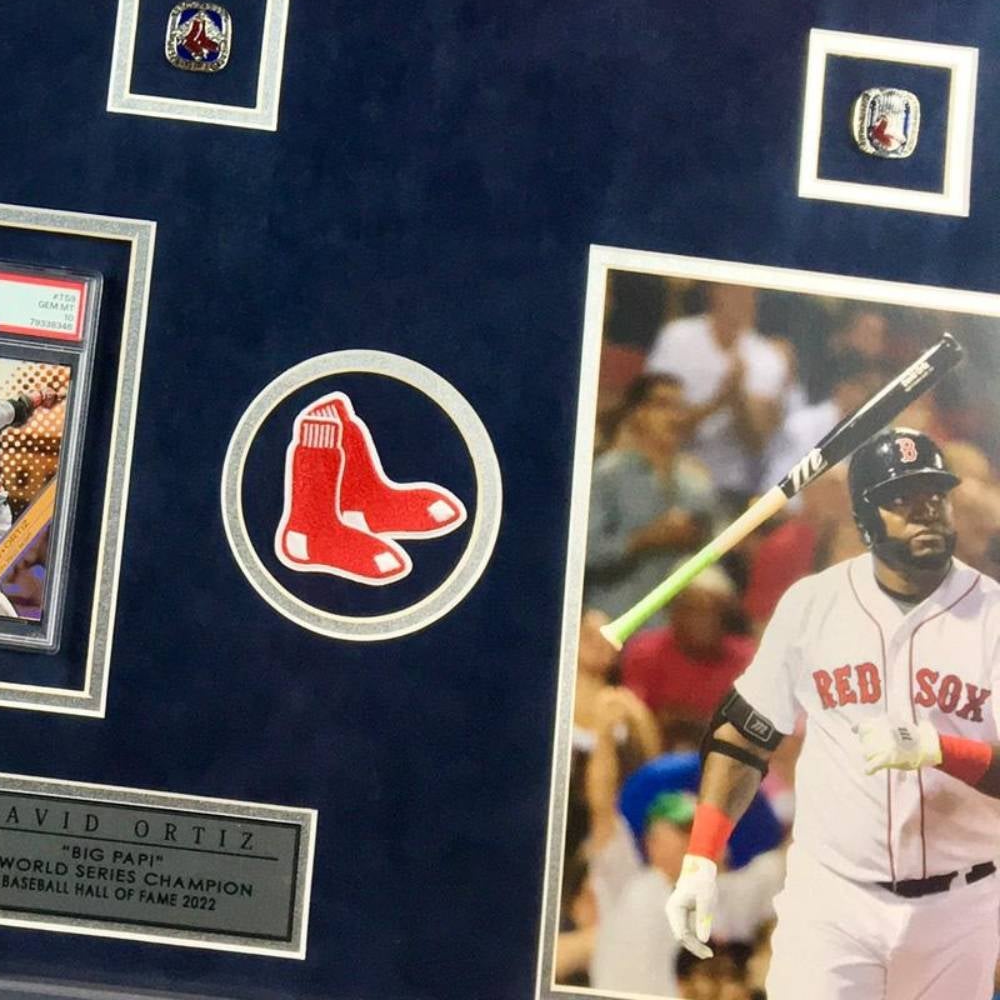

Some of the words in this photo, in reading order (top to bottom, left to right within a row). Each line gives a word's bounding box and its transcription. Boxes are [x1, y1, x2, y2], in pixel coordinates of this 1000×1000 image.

[38, 300, 59, 310] GEM
[60, 302, 74, 312] MT
[895, 437, 918, 463] B
[4, 519, 30, 549] ORTIZ
[812, 662, 882, 710] RED
[914, 667, 992, 723] SOX
[133, 820, 255, 851] ORTIZ
[62, 845, 105, 863] "BIG
[112, 850, 164, 868] PAPI"
[0, 855, 69, 878] WORLD
[75, 863, 137, 884] SERIES
[143, 871, 254, 898] CHAMPION
[1, 873, 70, 896] BASEBALL
[74, 883, 110, 900] HALL
[114, 886, 135, 901] OF
[138, 889, 178, 908] FAME
[182, 894, 217, 912] 2022
